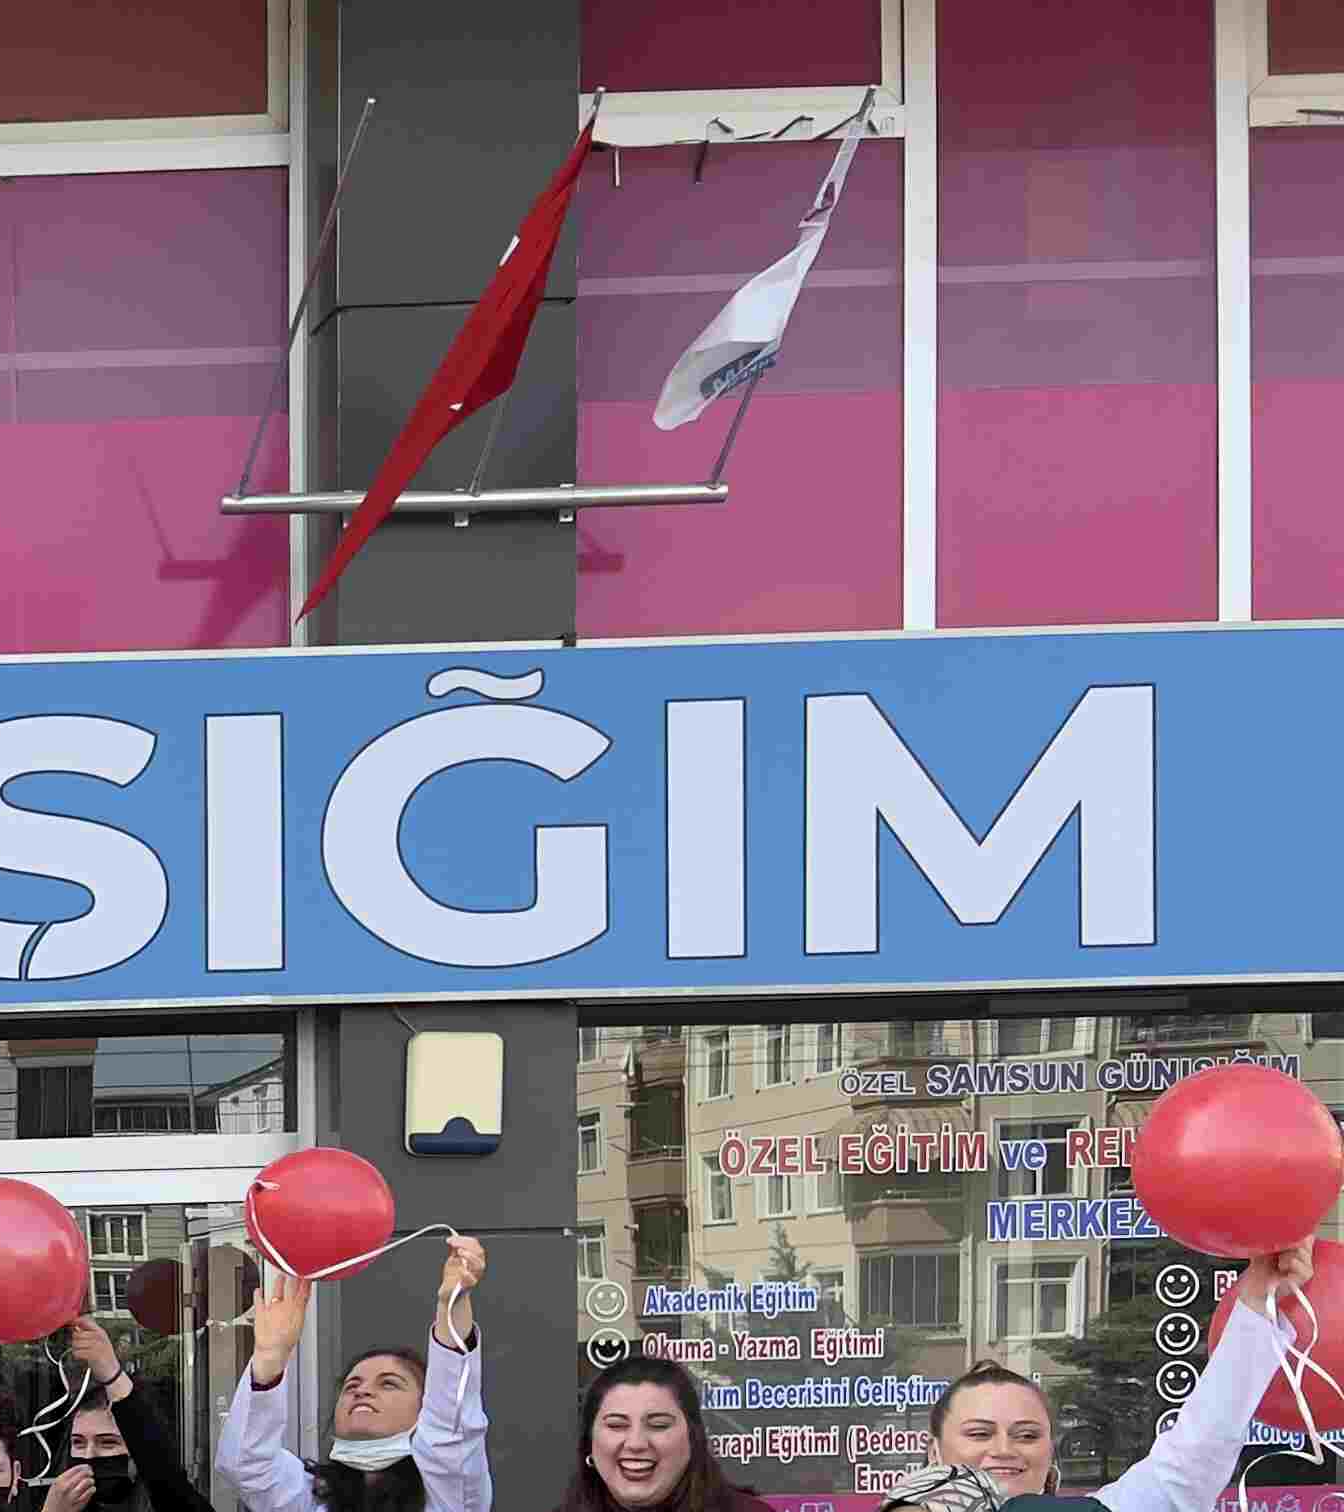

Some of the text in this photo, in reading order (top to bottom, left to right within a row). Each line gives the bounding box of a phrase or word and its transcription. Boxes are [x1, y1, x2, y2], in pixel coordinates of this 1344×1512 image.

[839, 1067, 916, 1097] ÖZEL
[926, 1058, 1087, 1097] SAMSUN
[719, 1129, 827, 1178] ÖZEL
[838, 1123, 989, 1175] EĞİTİM
[999, 1140, 1048, 1171] ve
[986, 1199, 1168, 1242] MERKEZ
[642, 1281, 818, 1319] Akademik Eğitim
[642, 1332, 714, 1361] Okuma
[732, 1330, 801, 1360] Yazma
[811, 1328, 885, 1366] Eğitimi
[746, 1377, 850, 1409] Becerisini
[854, 1375, 950, 1412] Geliştirm
[765, 1425, 839, 1464] Eğitimi
[846, 1425, 927, 1464] (Bedens
